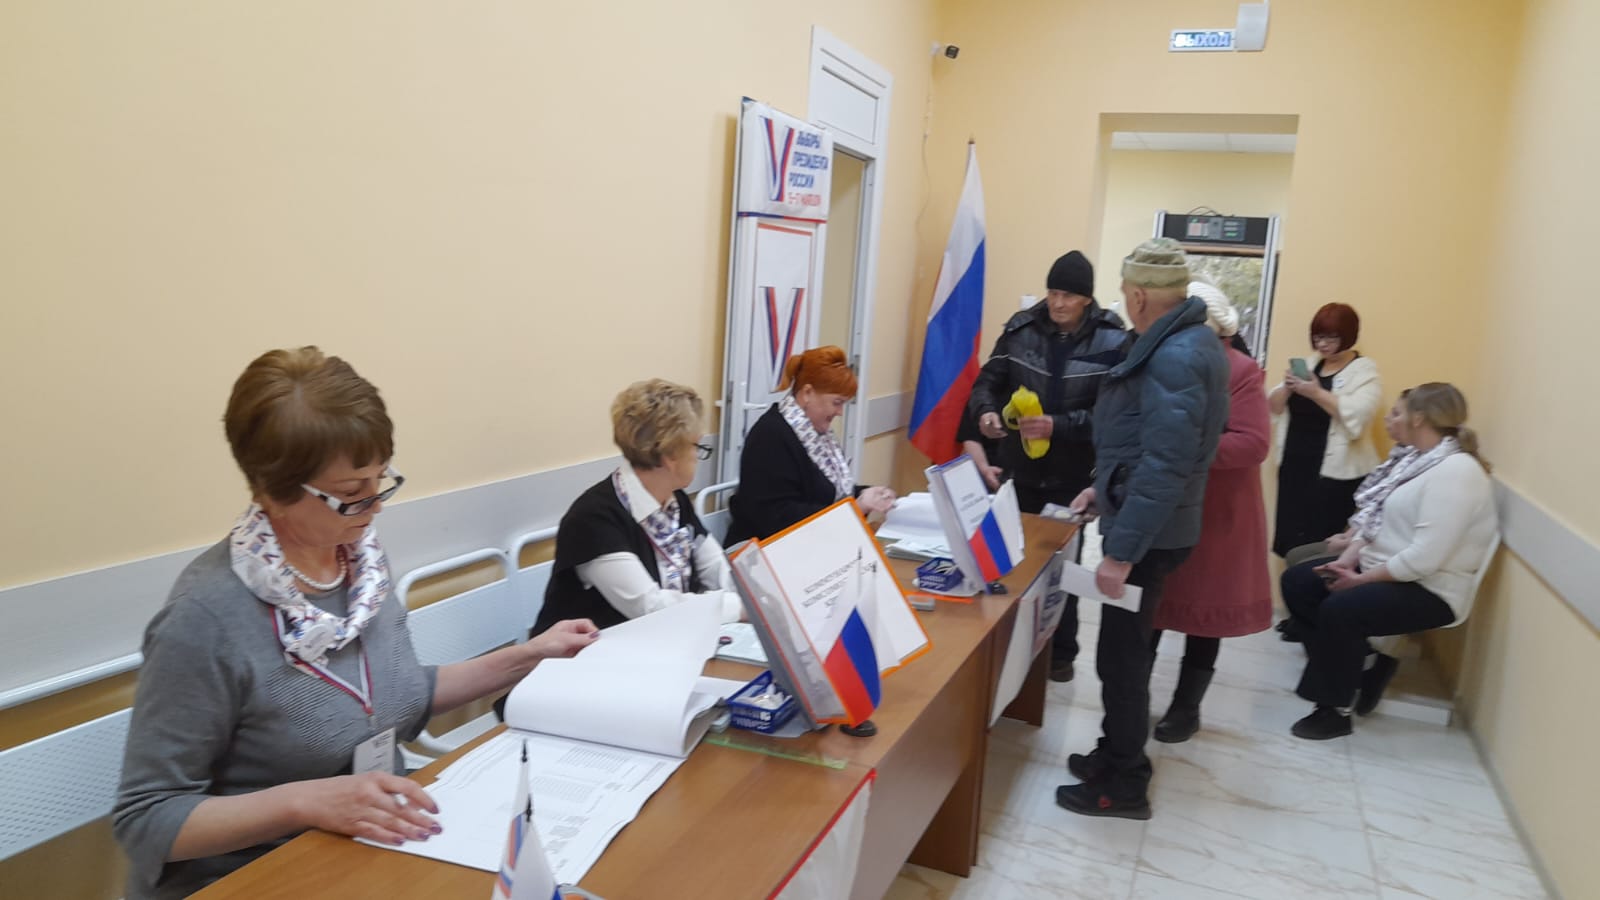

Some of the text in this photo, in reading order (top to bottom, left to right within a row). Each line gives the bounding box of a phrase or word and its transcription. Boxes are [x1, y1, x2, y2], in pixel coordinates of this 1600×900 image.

[1174, 32, 1231, 47] ВЫХОД
[796, 131, 821, 149] ВЫБОРЫ
[792, 151, 829, 170] ПРЕЗИДЕНТА
[788, 172, 815, 188] РОССИИ
